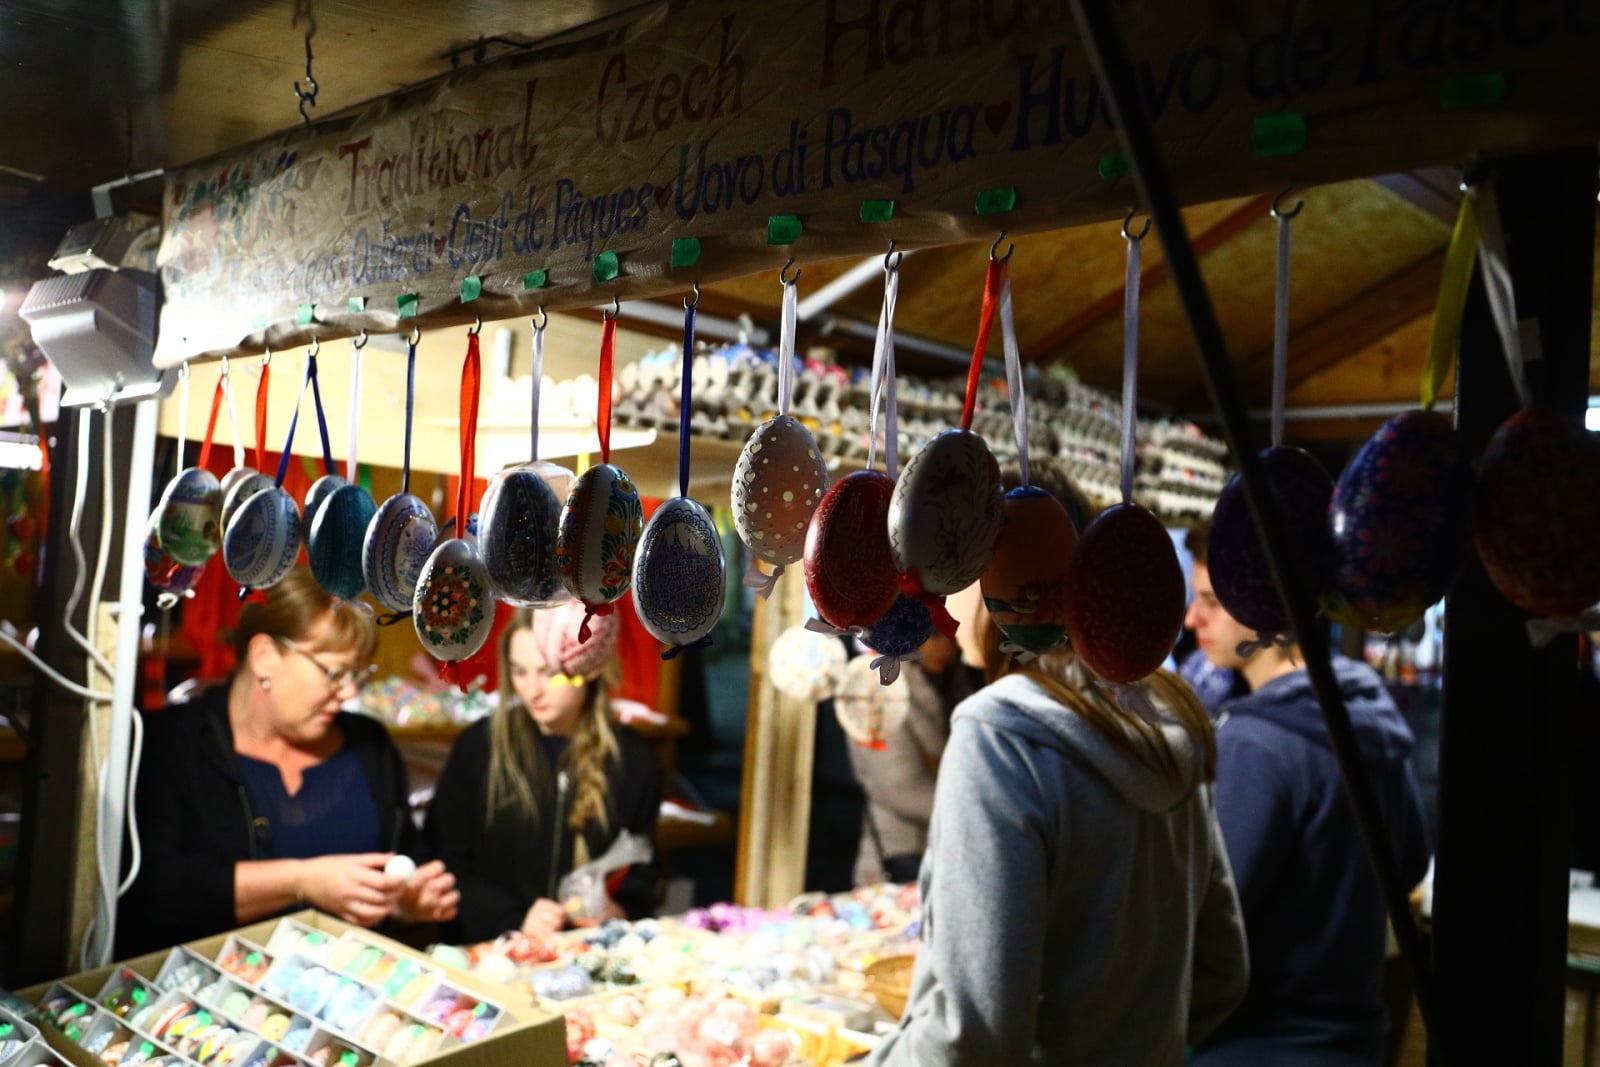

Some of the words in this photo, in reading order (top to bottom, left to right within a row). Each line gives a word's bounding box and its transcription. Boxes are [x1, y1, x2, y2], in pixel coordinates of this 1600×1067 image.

[338, 77, 540, 217] Traditional
[597, 12, 745, 148] Czech
[513, 185, 547, 254] de
[674, 139, 763, 222] Uovo
[772, 118, 806, 197] di
[822, 102, 981, 194] Pasqua
[1010, 45, 1223, 151] Huvo
[1244, 0, 1334, 98] de
